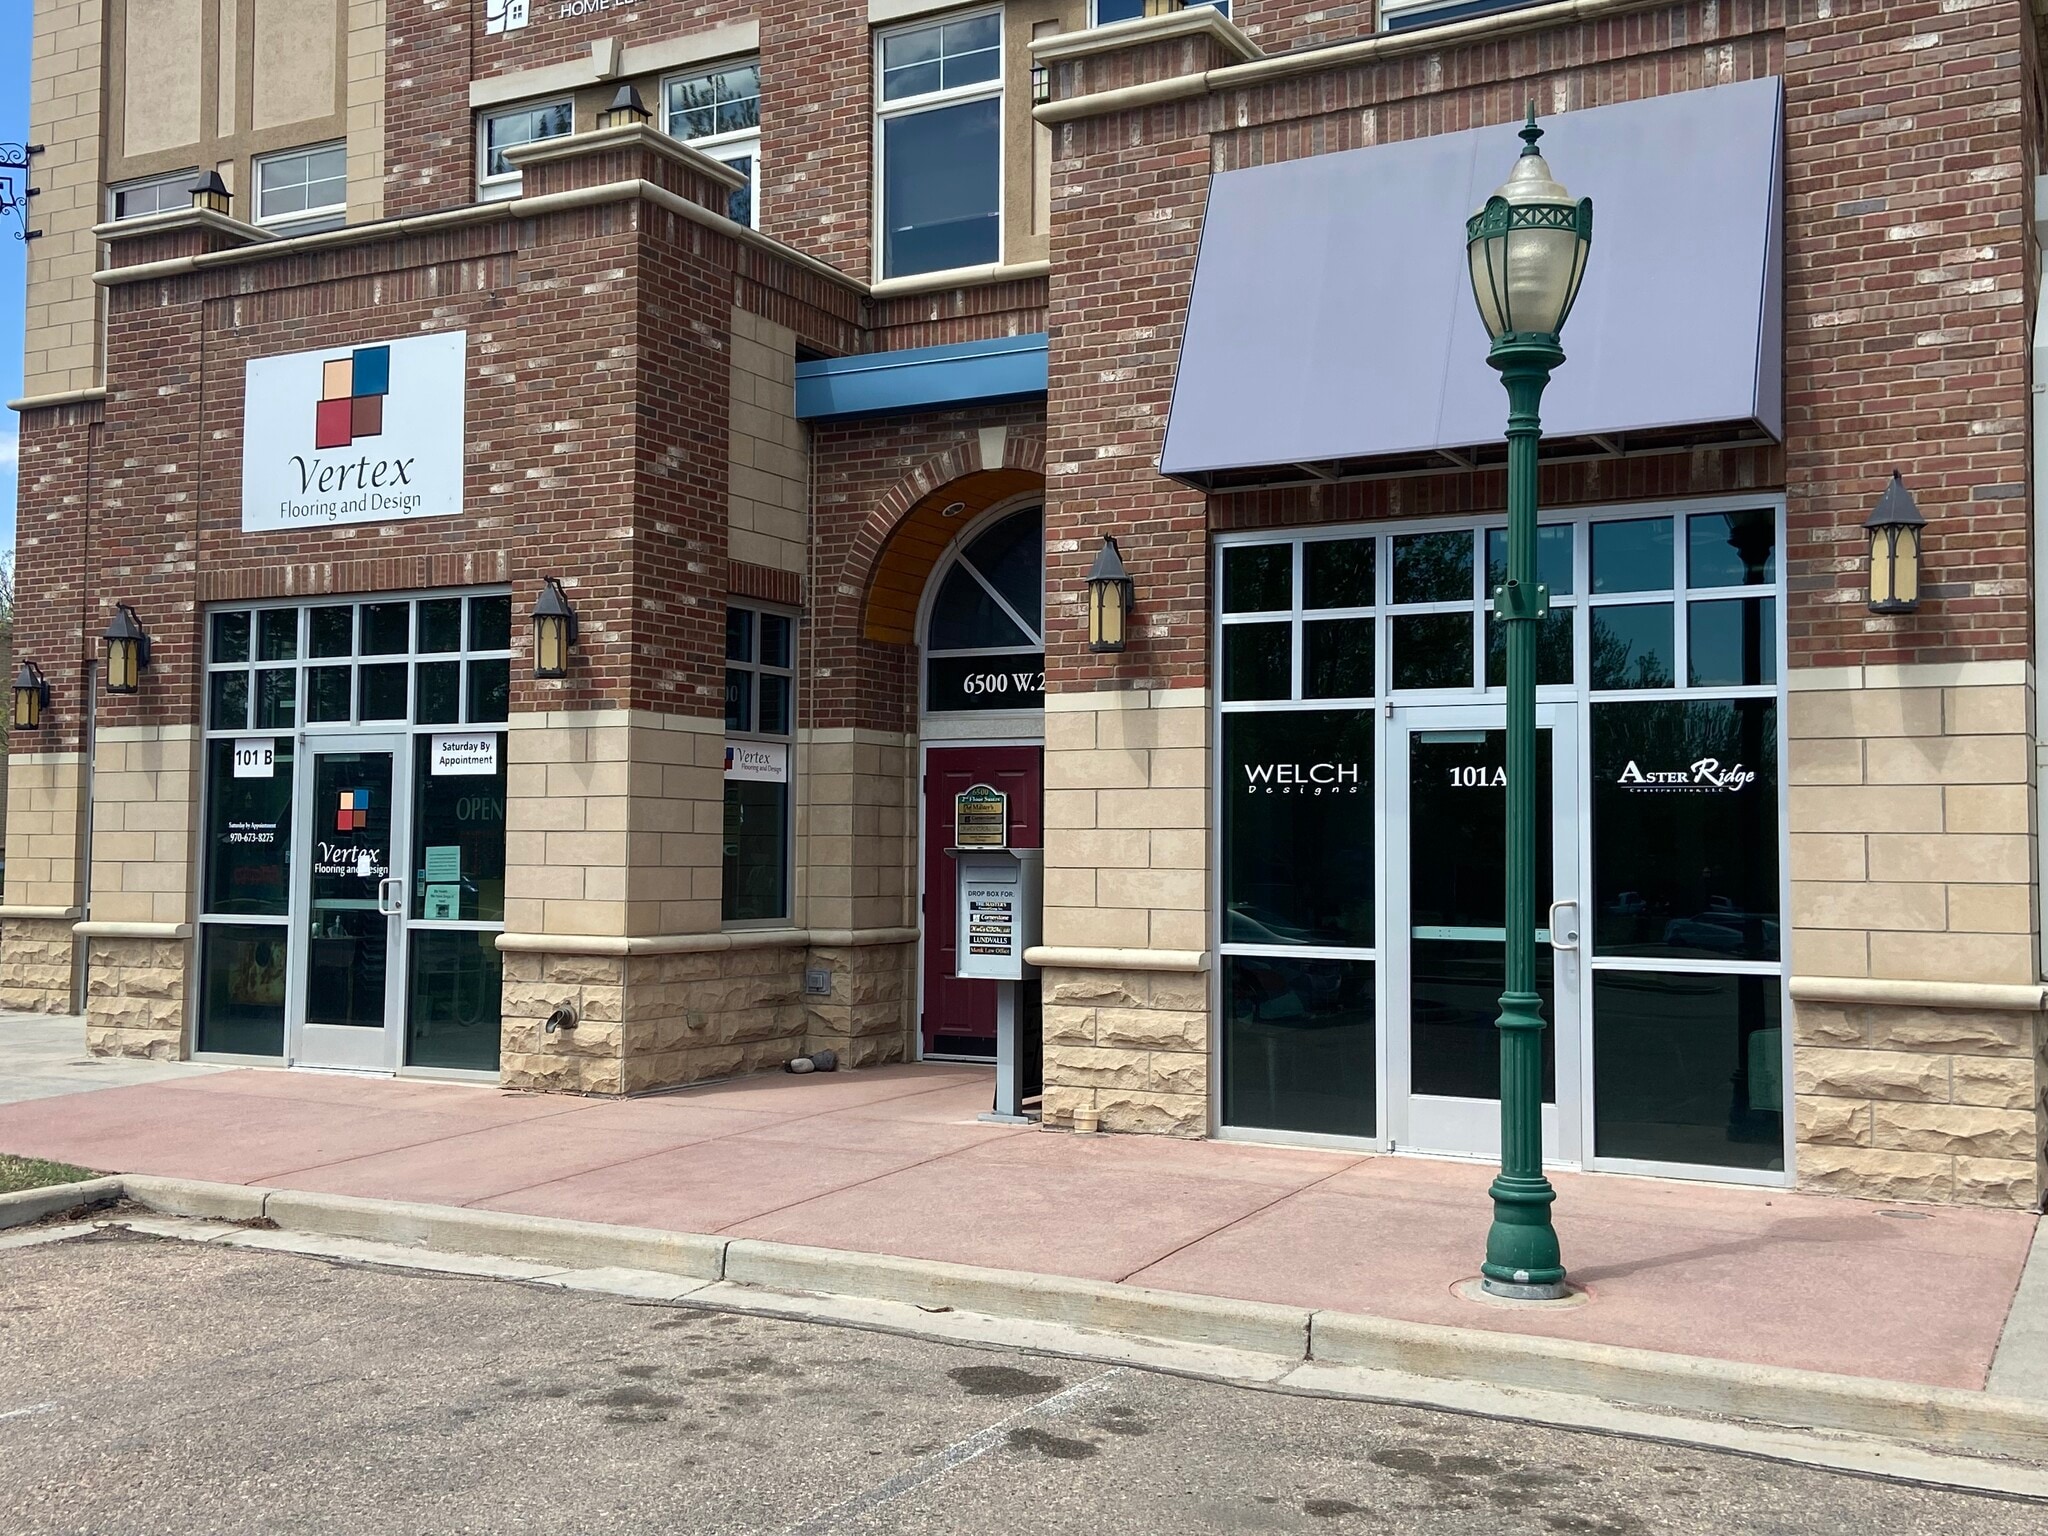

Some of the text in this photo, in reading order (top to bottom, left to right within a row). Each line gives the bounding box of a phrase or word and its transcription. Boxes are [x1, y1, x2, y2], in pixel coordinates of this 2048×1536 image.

[560, 0, 610, 19] HOME
[288, 455, 415, 495] Vertex
[280, 491, 422, 521] Flooring and Design
[963, 672, 1008, 695] 6500
[442, 741, 491, 753] Saturday By
[736, 747, 771, 764] Vertex
[235, 749, 273, 766] 101 B
[439, 754, 493, 767] Appointment
[1244, 763, 1358, 783] WELCH
[1449, 766, 1508, 787] 101A
[1690, 757, 1755, 791] Ridge
[1248, 785, 1358, 796] Designs
[456, 796, 503, 821] OPEN
[230, 832, 274, 843] 970-673-8275
[314, 862, 346, 877] Flooring
[369, 864, 389, 878] esign
[974, 936, 1007, 944] LUNDVALLS
